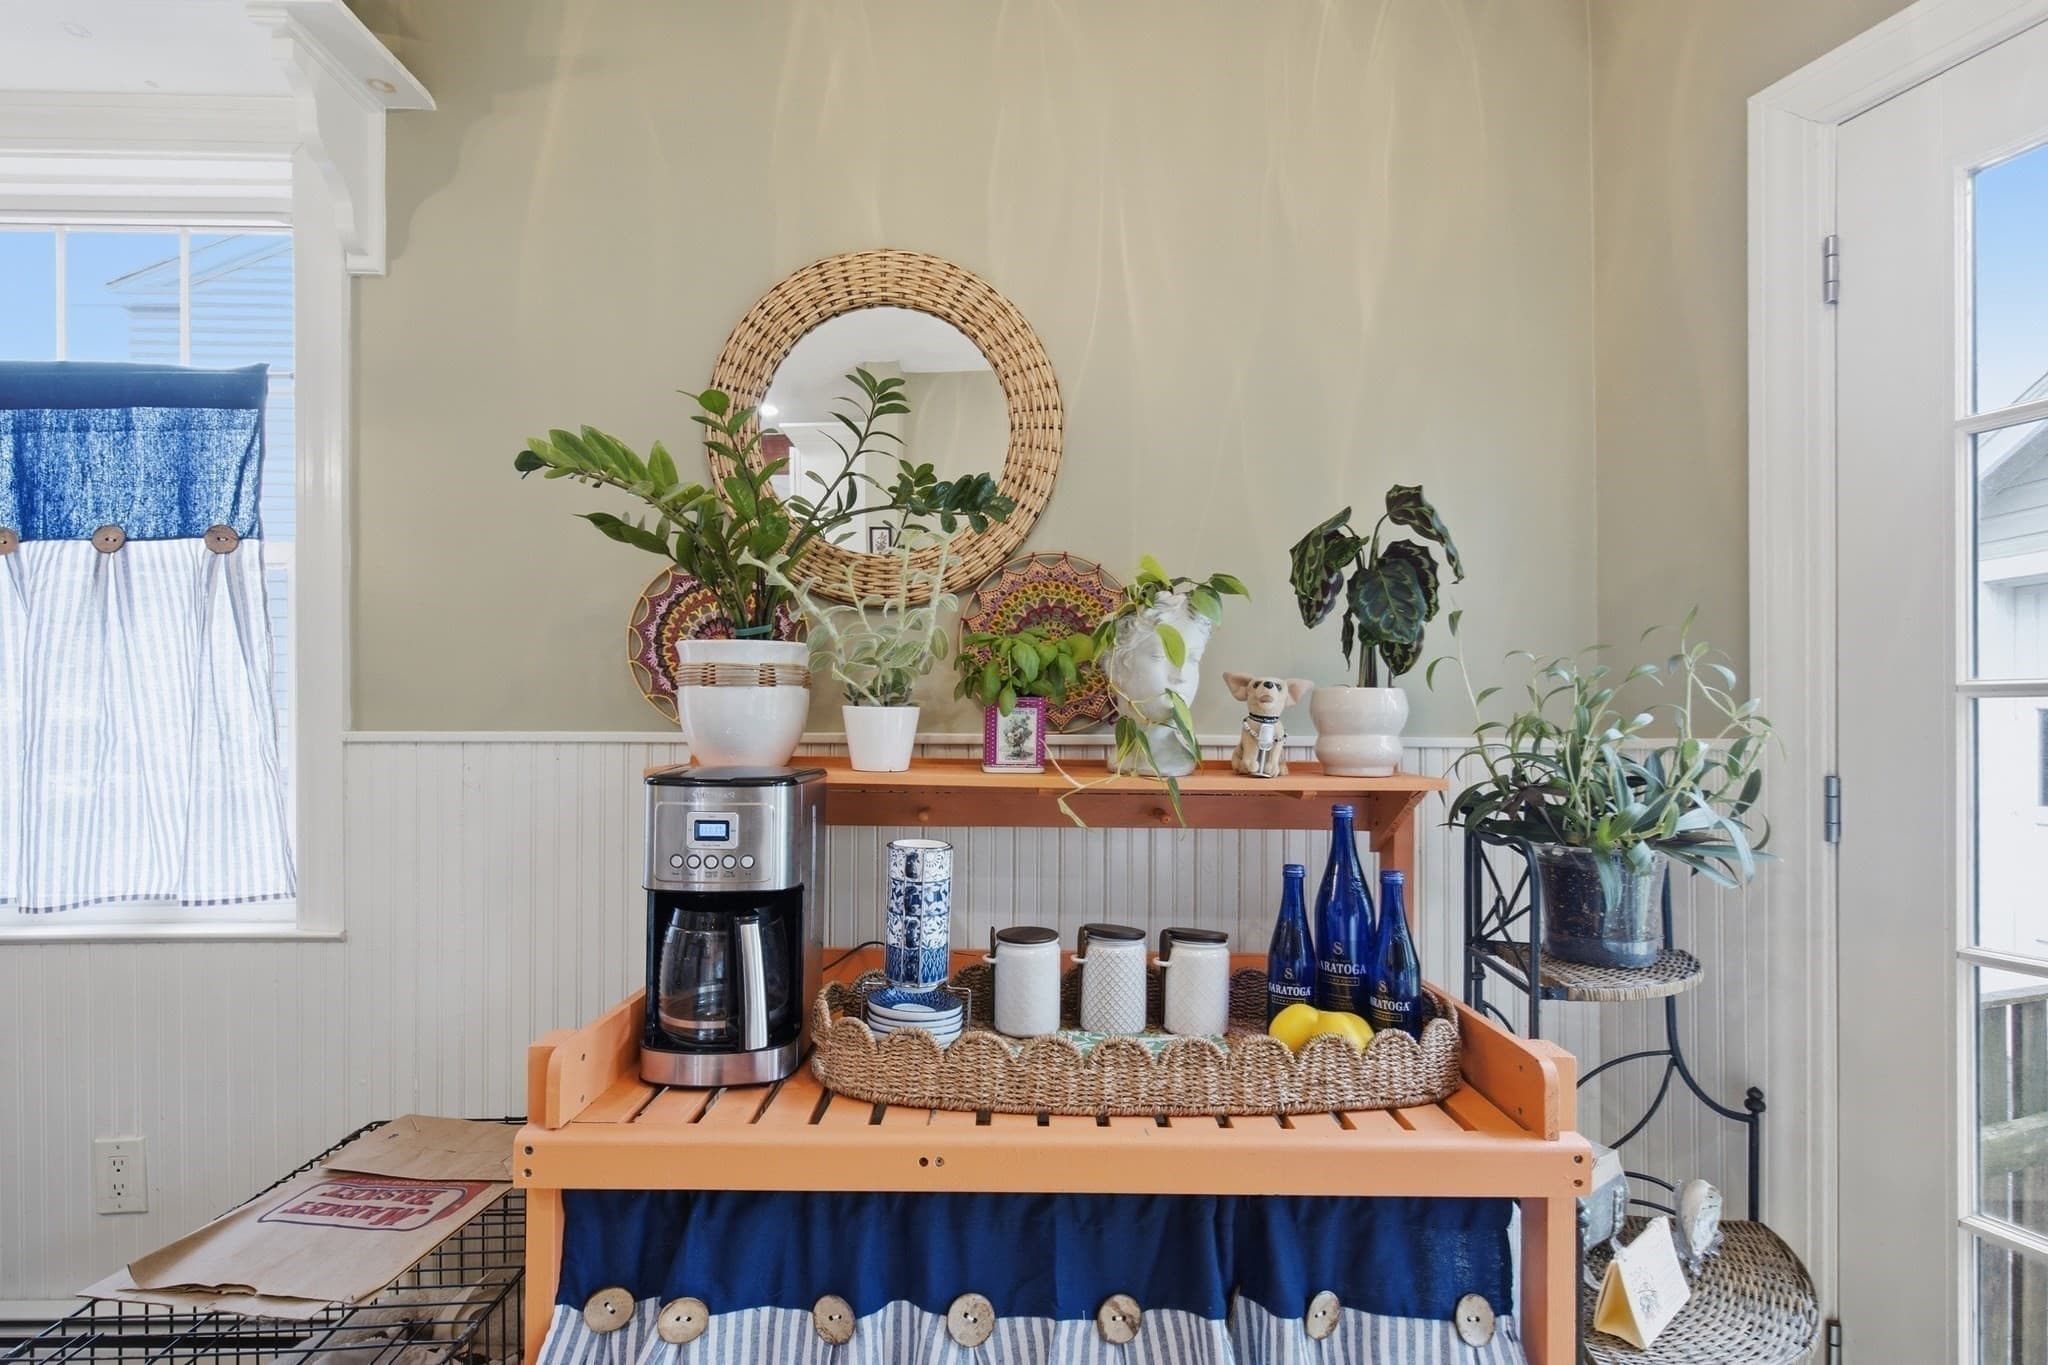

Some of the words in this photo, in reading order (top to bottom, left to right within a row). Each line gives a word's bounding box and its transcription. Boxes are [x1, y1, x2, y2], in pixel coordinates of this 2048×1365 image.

[1268, 982, 1312, 997] SARATOGA
[319, 1187, 448, 1205] BASKET
[280, 1201, 430, 1226] MARKET
